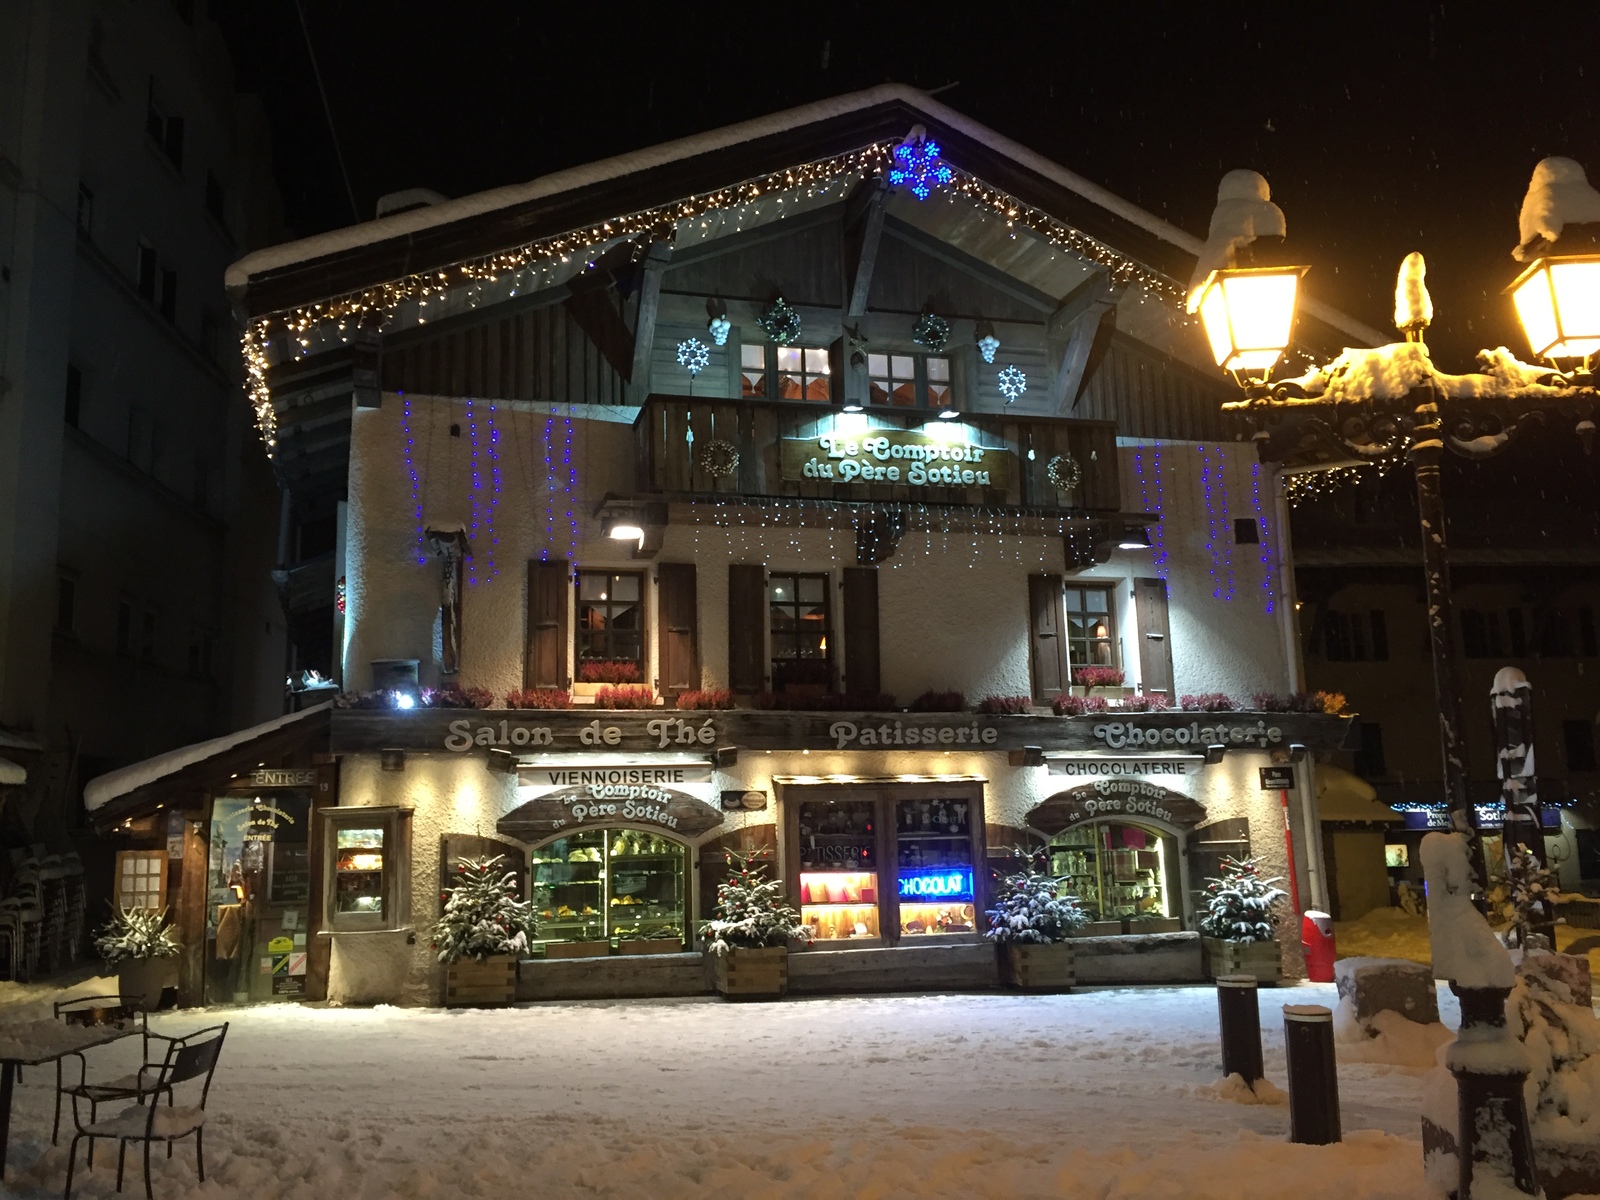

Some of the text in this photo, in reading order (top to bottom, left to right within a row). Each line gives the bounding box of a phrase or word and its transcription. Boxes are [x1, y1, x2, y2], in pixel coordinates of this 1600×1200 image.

[819, 435, 985, 463] Le Comptoir
[803, 458, 991, 485] du Père Sotieu
[444, 717, 716, 751] Salon de Thé
[829, 720, 998, 749] Patisserie
[1093, 720, 1282, 748] Chocolaterie
[548, 769, 684, 785] VIENNOISERIE
[1065, 762, 1186, 776] CHOCOLATERIE
[585, 784, 672, 804] Comptoir
[1093, 779, 1166, 801] Comptoir
[572, 803, 616, 823] Père
[622, 800, 678, 829] Sotieu
[1084, 799, 1121, 817] Père
[1125, 796, 1172, 823] Sotieu
